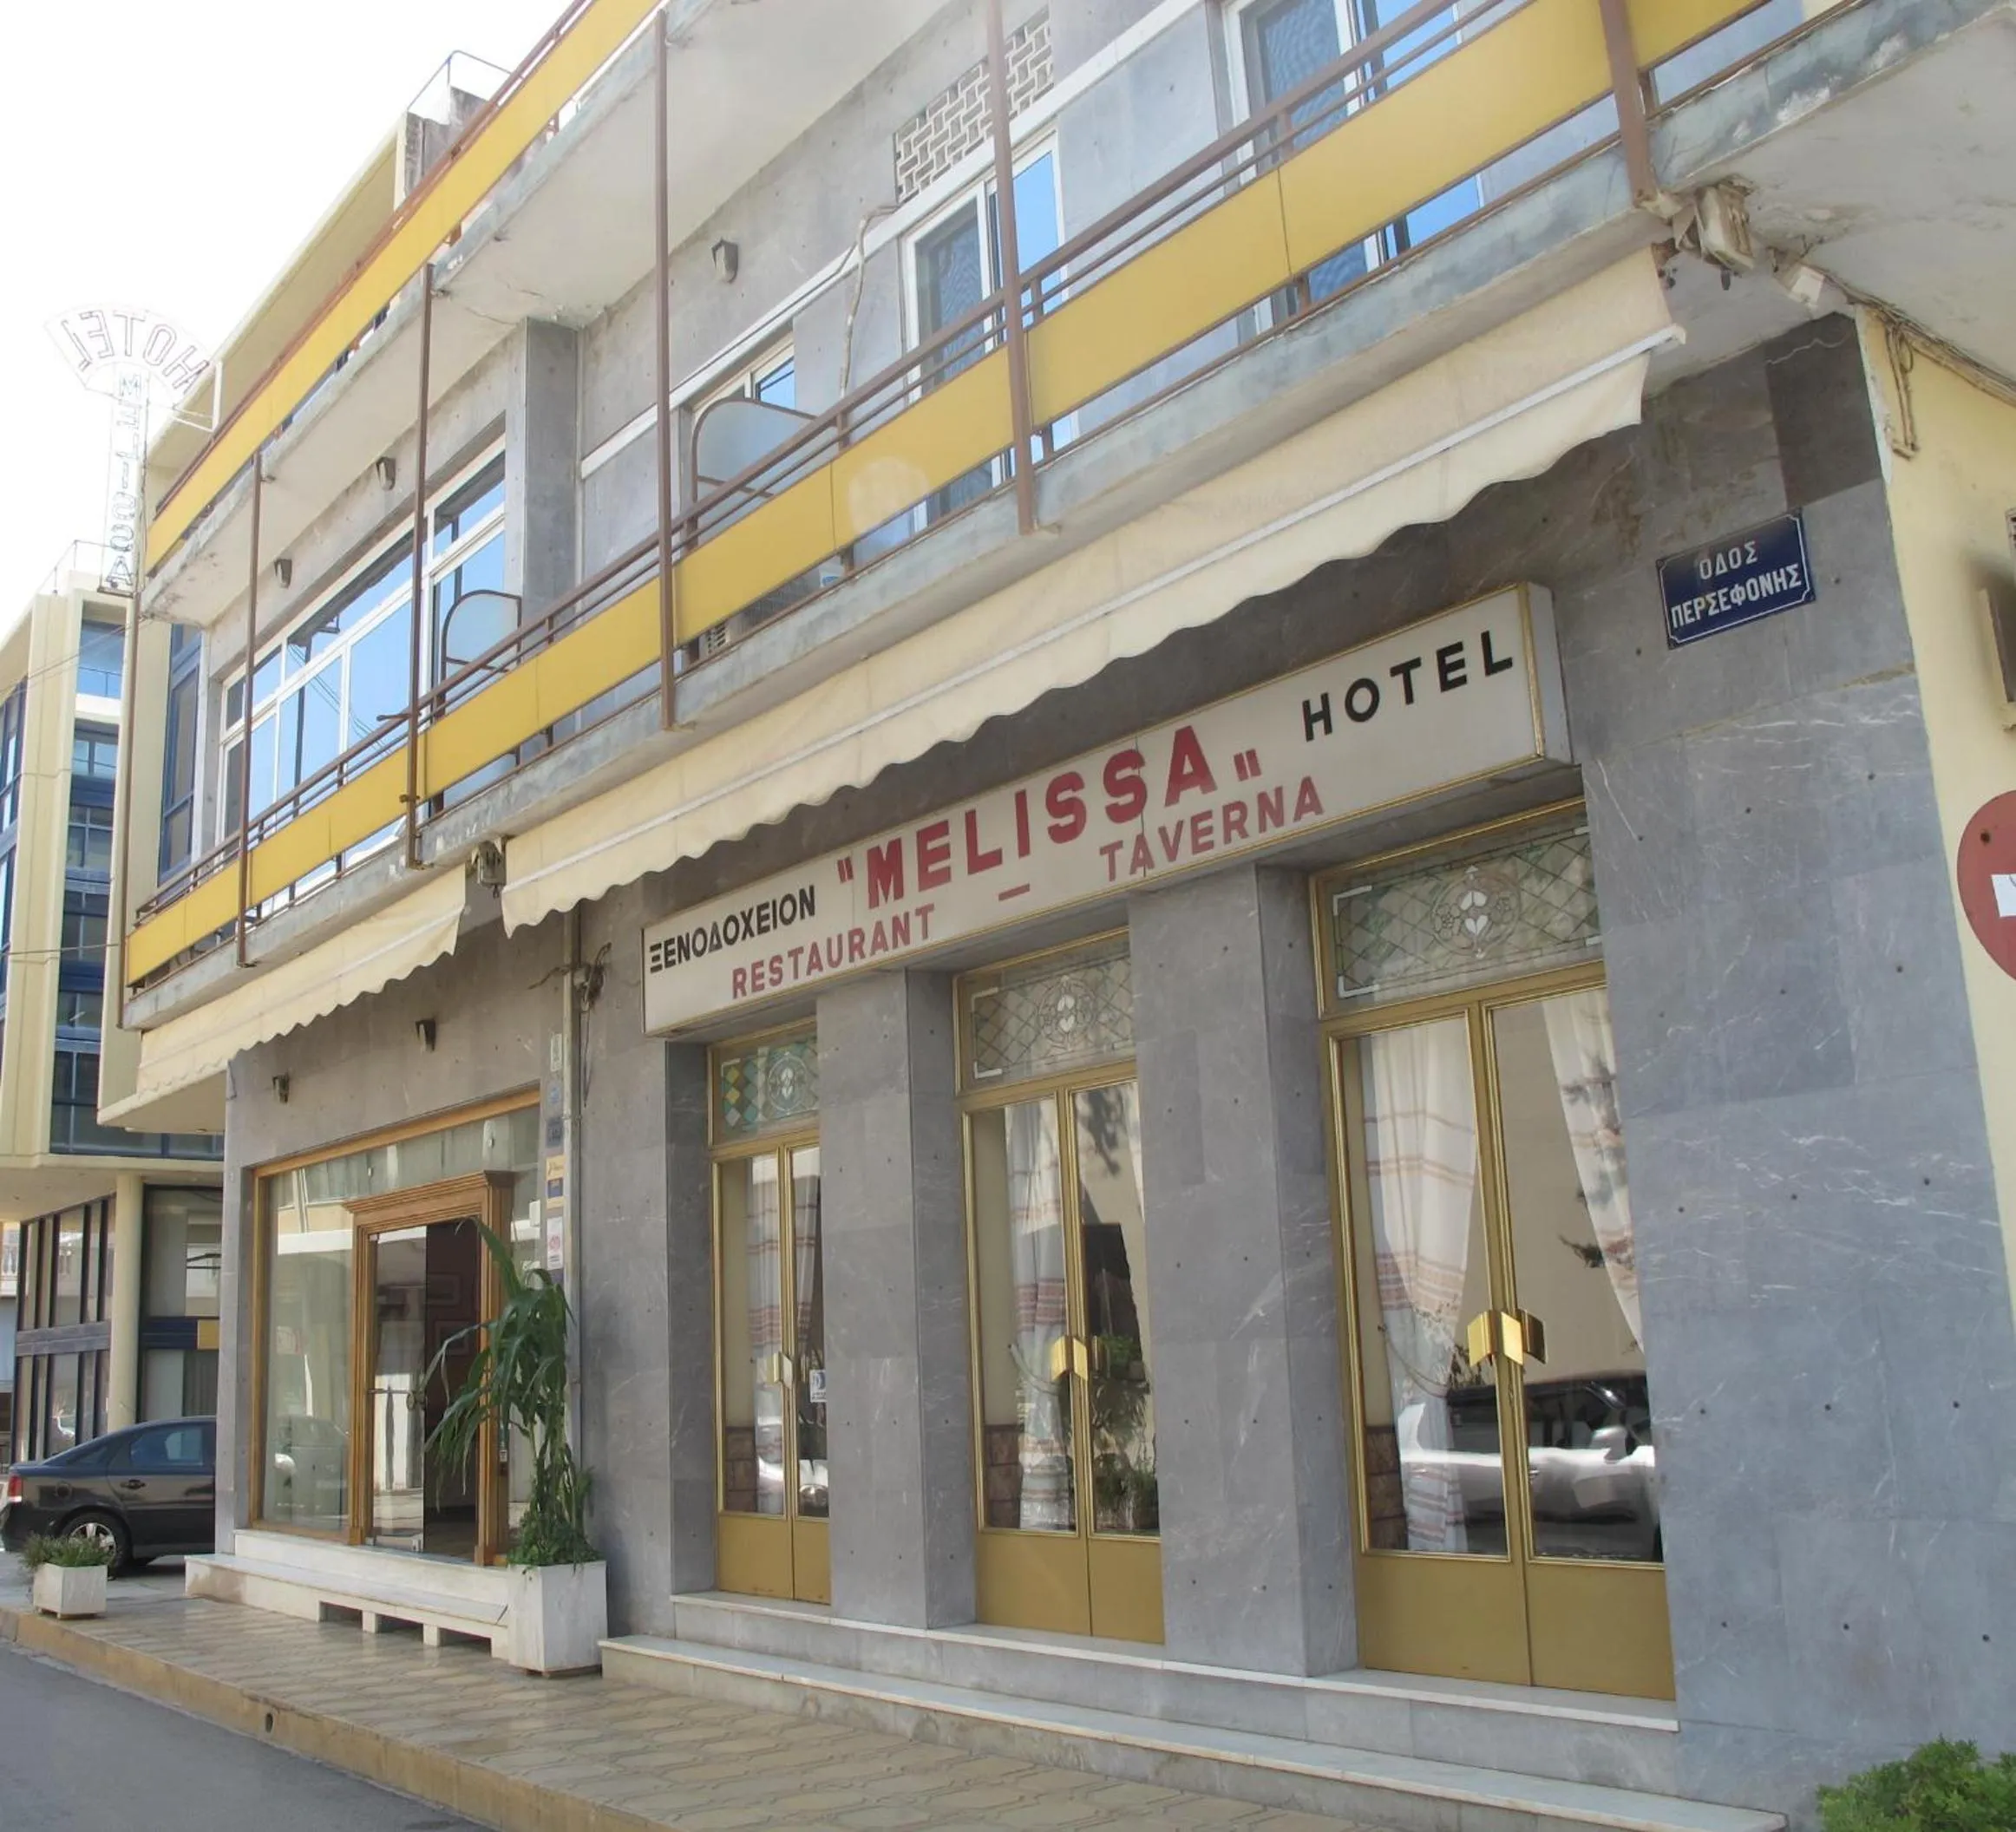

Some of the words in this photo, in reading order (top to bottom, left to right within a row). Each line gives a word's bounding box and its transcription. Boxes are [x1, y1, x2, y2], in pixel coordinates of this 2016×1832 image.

[1671, 564, 1802, 628] ΠΕΡΣΕΦΟΝΗΣ
[1699, 540, 1758, 579] ΟΔΟΣ
[1302, 631, 1513, 742] HOTEL
[650, 885, 816, 973] ΞΕΝΟΔΟΧΕΙΟΝ
[731, 904, 935, 999] RESTAURANT
[1100, 775, 1324, 882] TAVERNA
